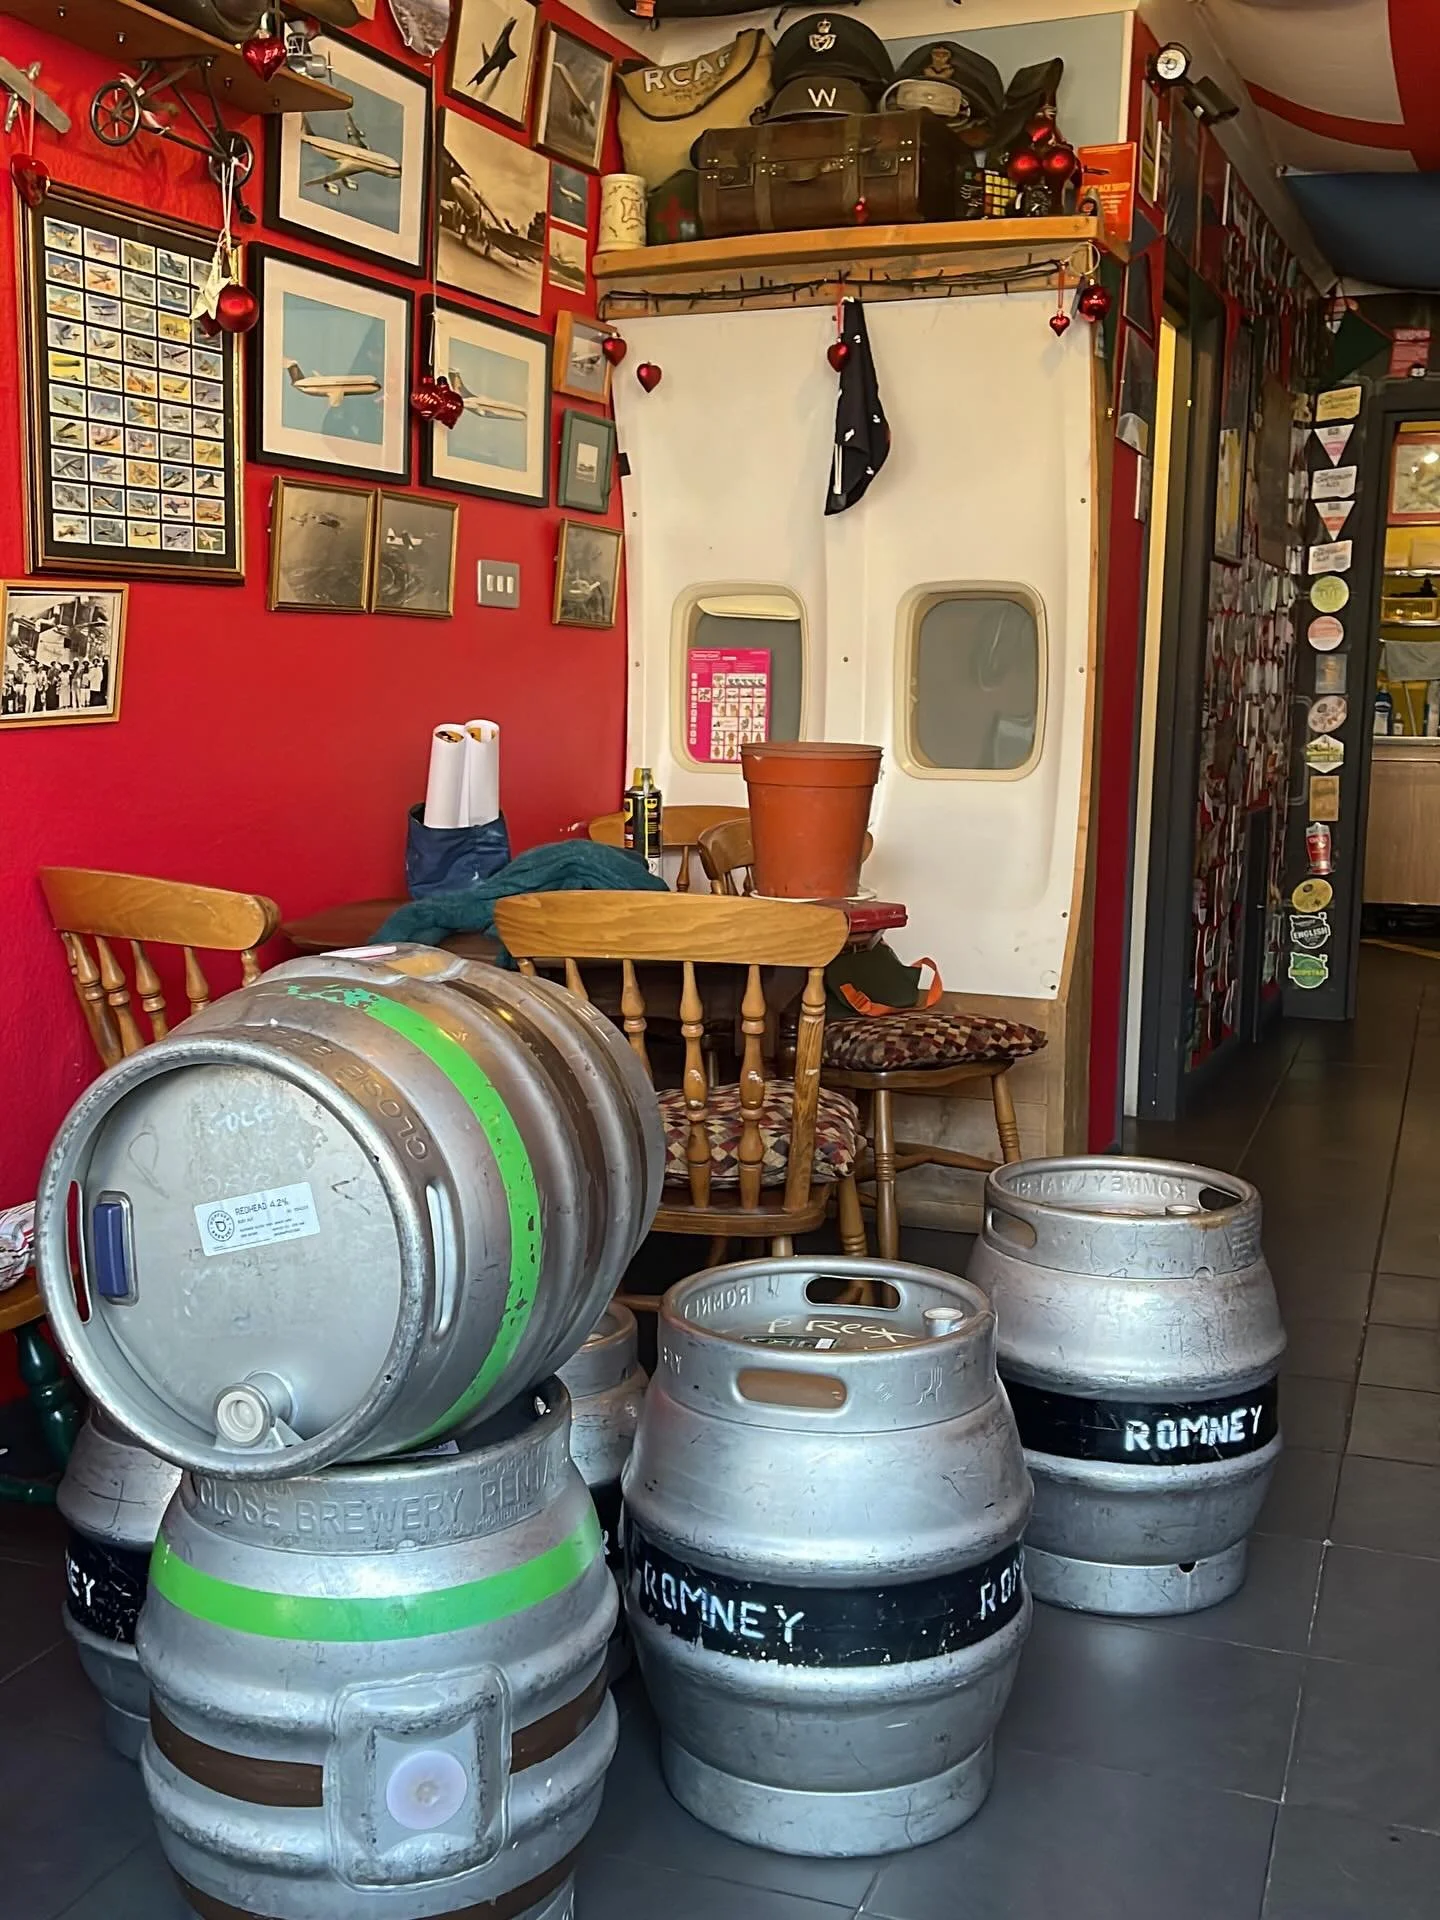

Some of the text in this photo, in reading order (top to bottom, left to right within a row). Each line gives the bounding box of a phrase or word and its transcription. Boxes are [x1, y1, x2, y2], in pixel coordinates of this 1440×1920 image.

[807, 87, 837, 107] W
[234, 1202, 267, 1215] REDHEAD
[1124, 1404, 1263, 1452] ROMNEY
[200, 1477, 282, 1530] CLOSE
[296, 1487, 464, 1534] BREWERY
[644, 1559, 805, 1645] ROMNEY
